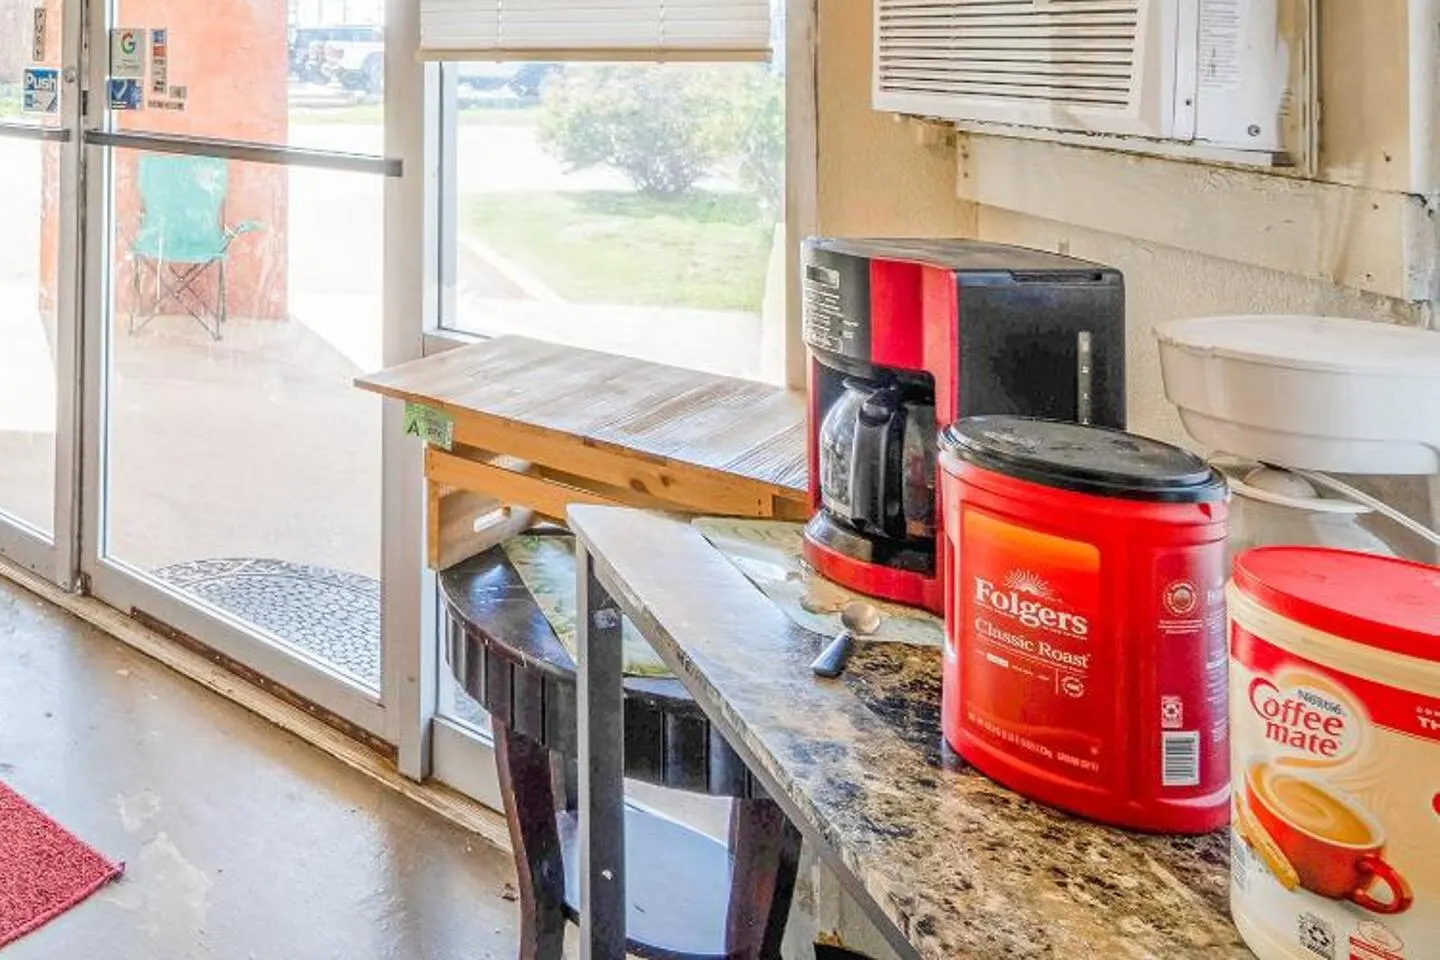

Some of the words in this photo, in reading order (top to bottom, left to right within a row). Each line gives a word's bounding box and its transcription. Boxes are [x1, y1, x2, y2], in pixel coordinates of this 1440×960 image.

[121, 32, 136, 55] G
[25, 73, 57, 90] Push
[974, 576, 1089, 635] Folgers
[974, 617, 1035, 652] Classic
[1038, 639, 1090, 668] Roast
[1248, 677, 1344, 737] Coffee
[1265, 719, 1339, 758] mate
